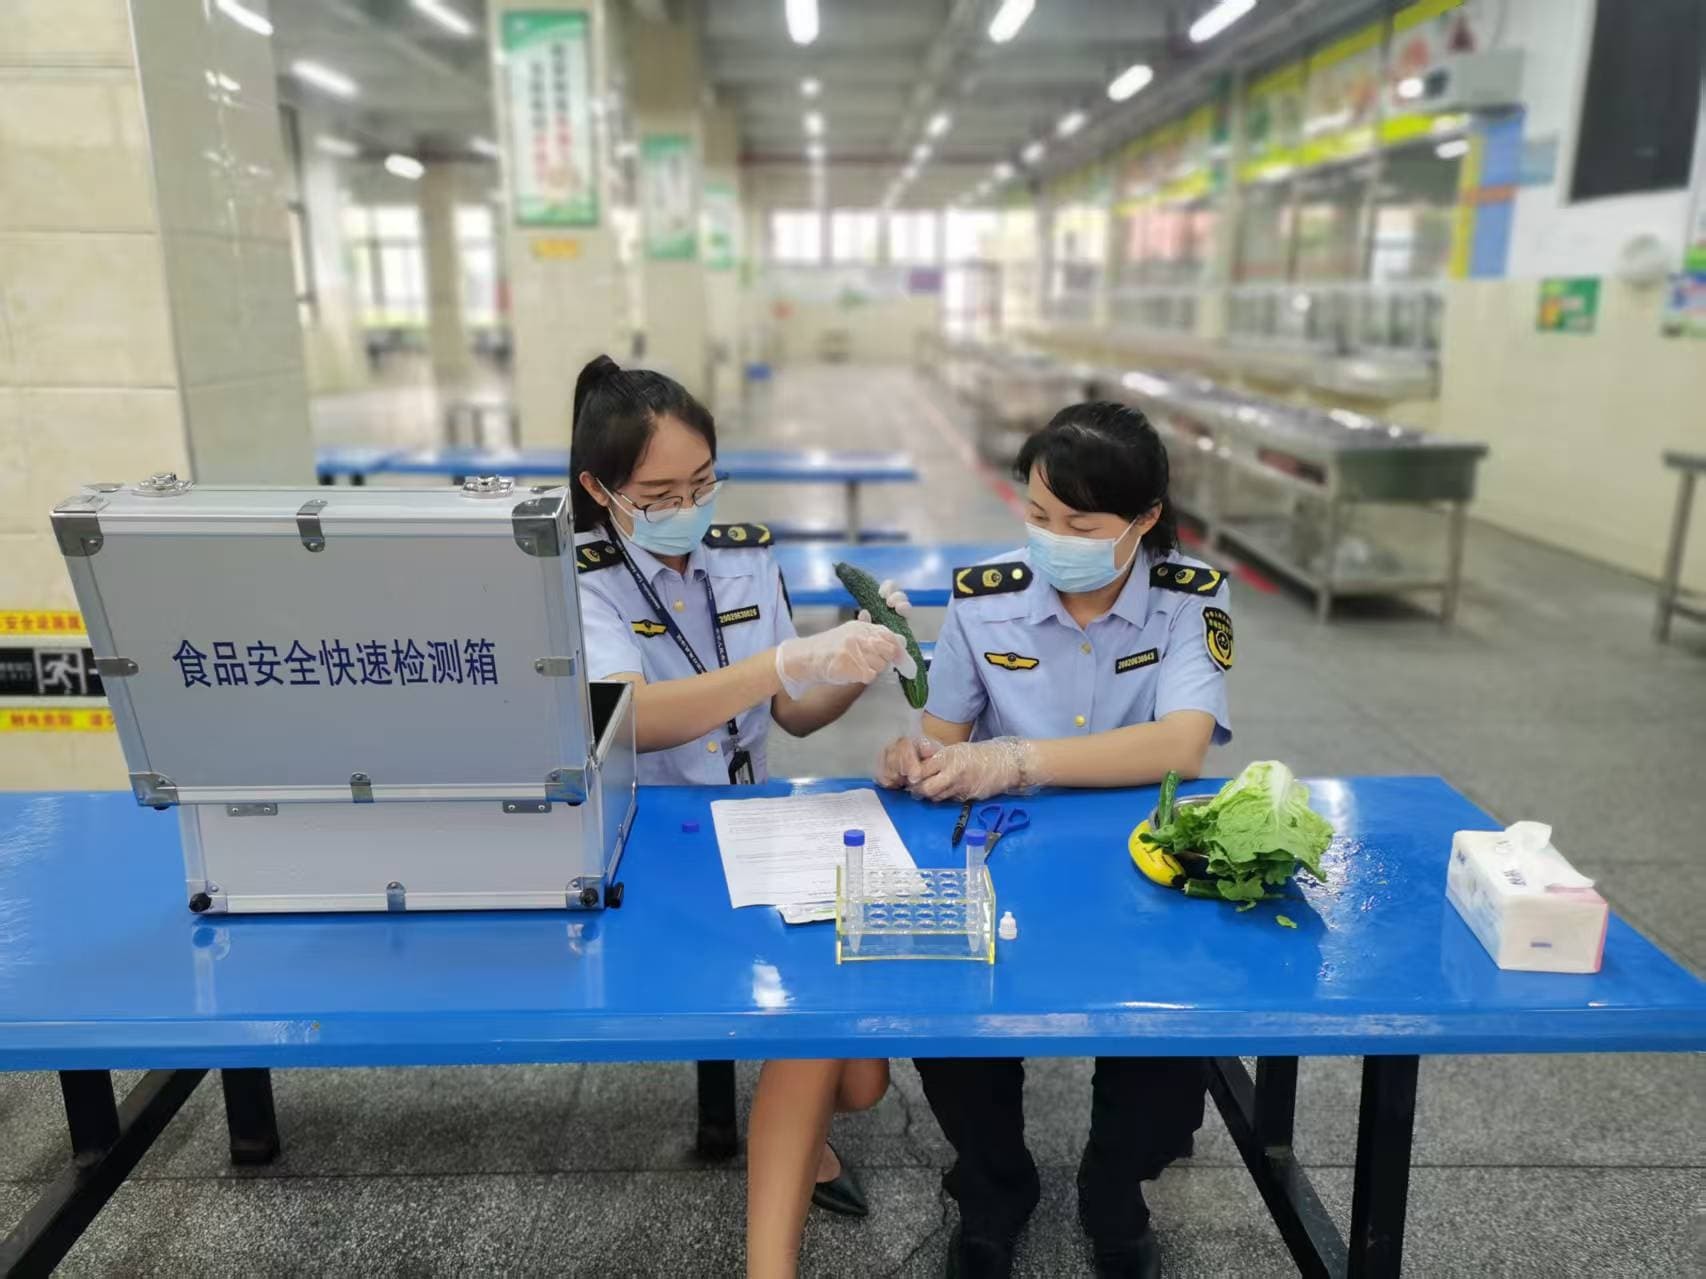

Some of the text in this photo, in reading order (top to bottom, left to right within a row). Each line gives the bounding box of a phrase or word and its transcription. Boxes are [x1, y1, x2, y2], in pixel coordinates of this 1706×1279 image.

[172, 638, 499, 688] 食品安全快速检测箱
